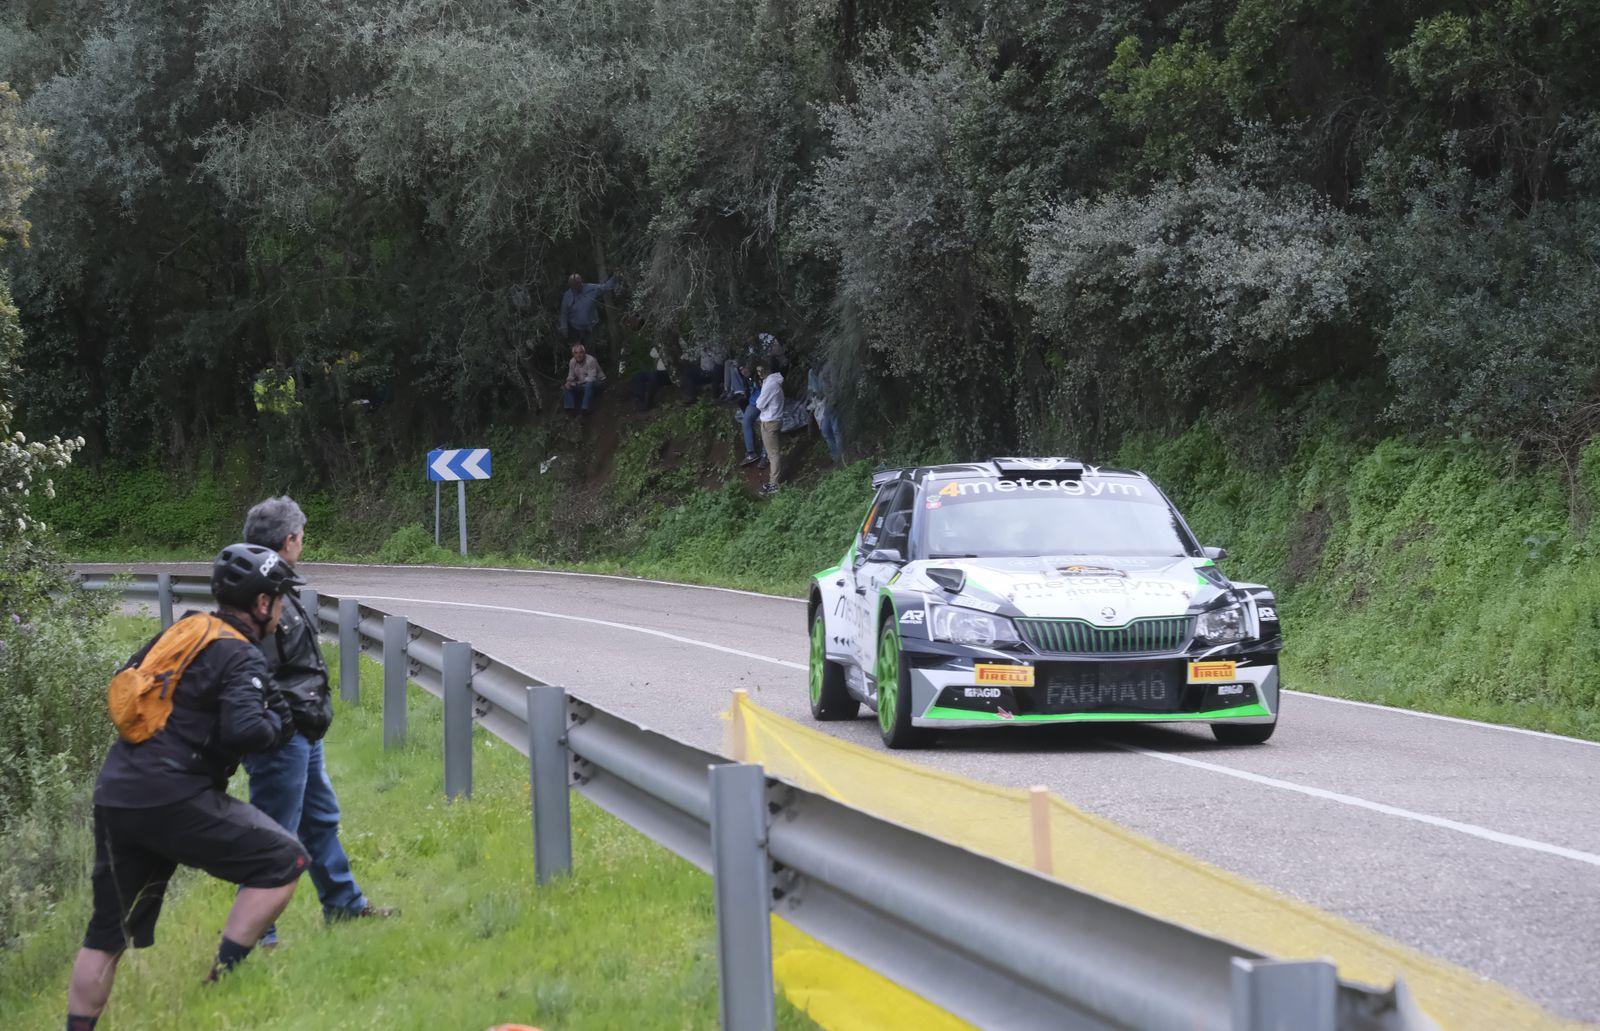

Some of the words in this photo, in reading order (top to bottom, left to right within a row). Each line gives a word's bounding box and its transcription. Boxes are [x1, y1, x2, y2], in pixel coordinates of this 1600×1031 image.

[939, 481, 960, 497] 4
[960, 477, 1142, 497] metagym
[1012, 577, 1176, 591] metagym
[979, 667, 1028, 681] PIRELLI
[1193, 664, 1233, 678] PIRELLI
[973, 687, 1002, 698] FAGID
[1046, 680, 1167, 705] FARMA10
